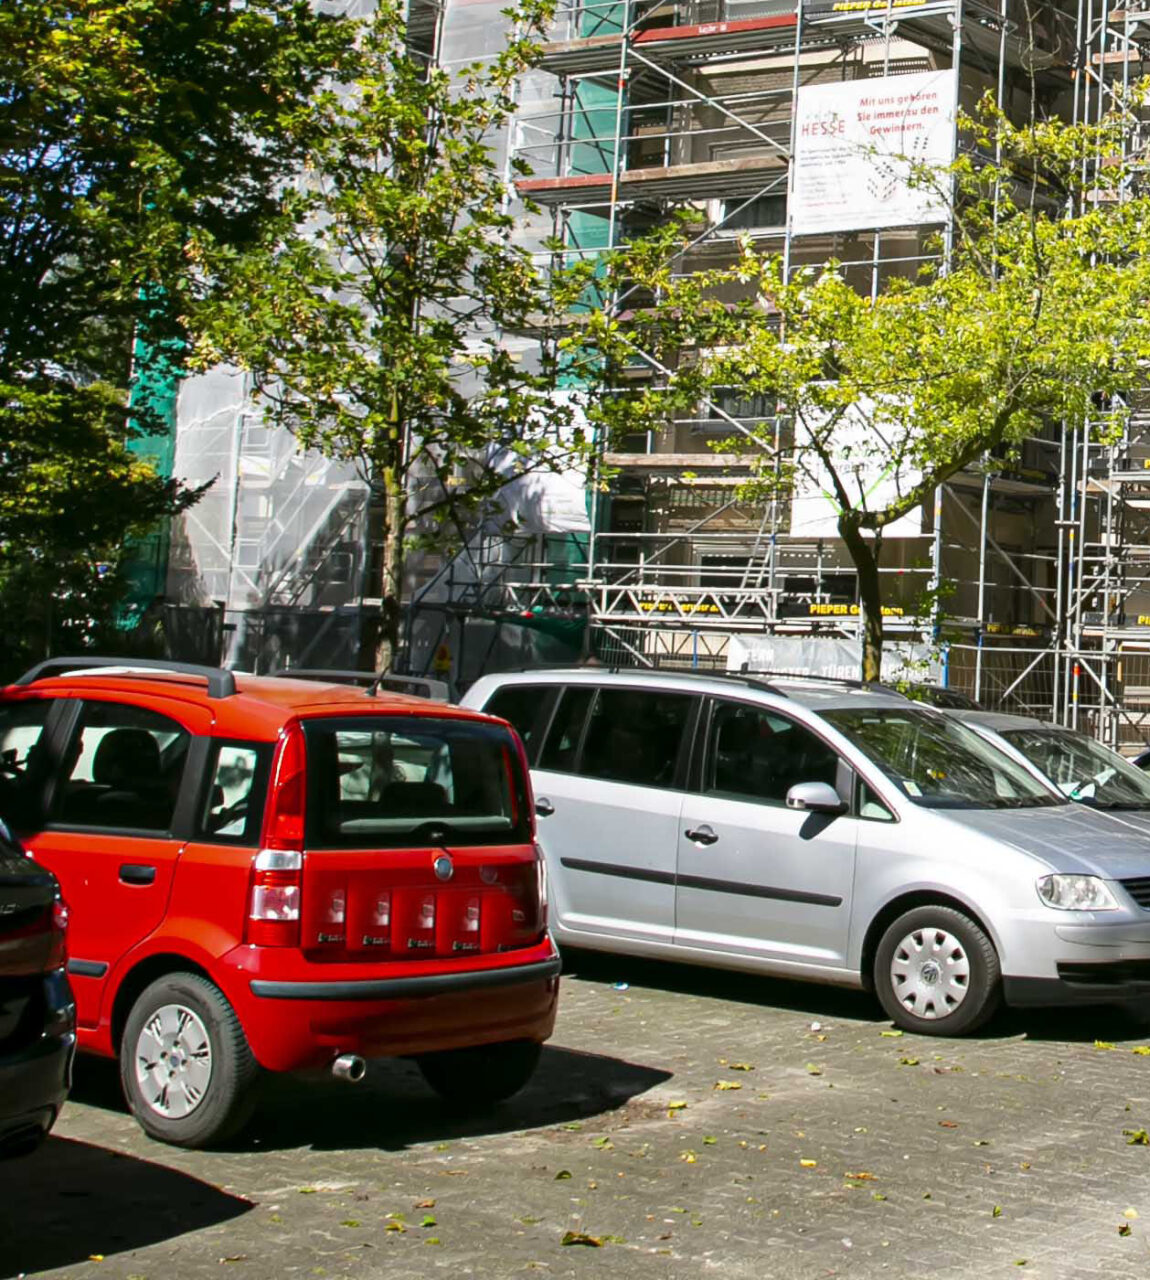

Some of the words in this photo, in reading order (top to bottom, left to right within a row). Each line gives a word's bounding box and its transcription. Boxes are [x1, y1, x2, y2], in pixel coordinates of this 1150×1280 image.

[832, 0, 872, 11] PIEPER
[860, 98, 876, 107] Mit
[878, 96, 895, 106] uns
[857, 111, 872, 122] Sie
[873, 110, 904, 121] immer
[920, 105, 939, 116] den
[801, 120, 846, 137] HESSE
[810, 604, 848, 614] PIEPER
